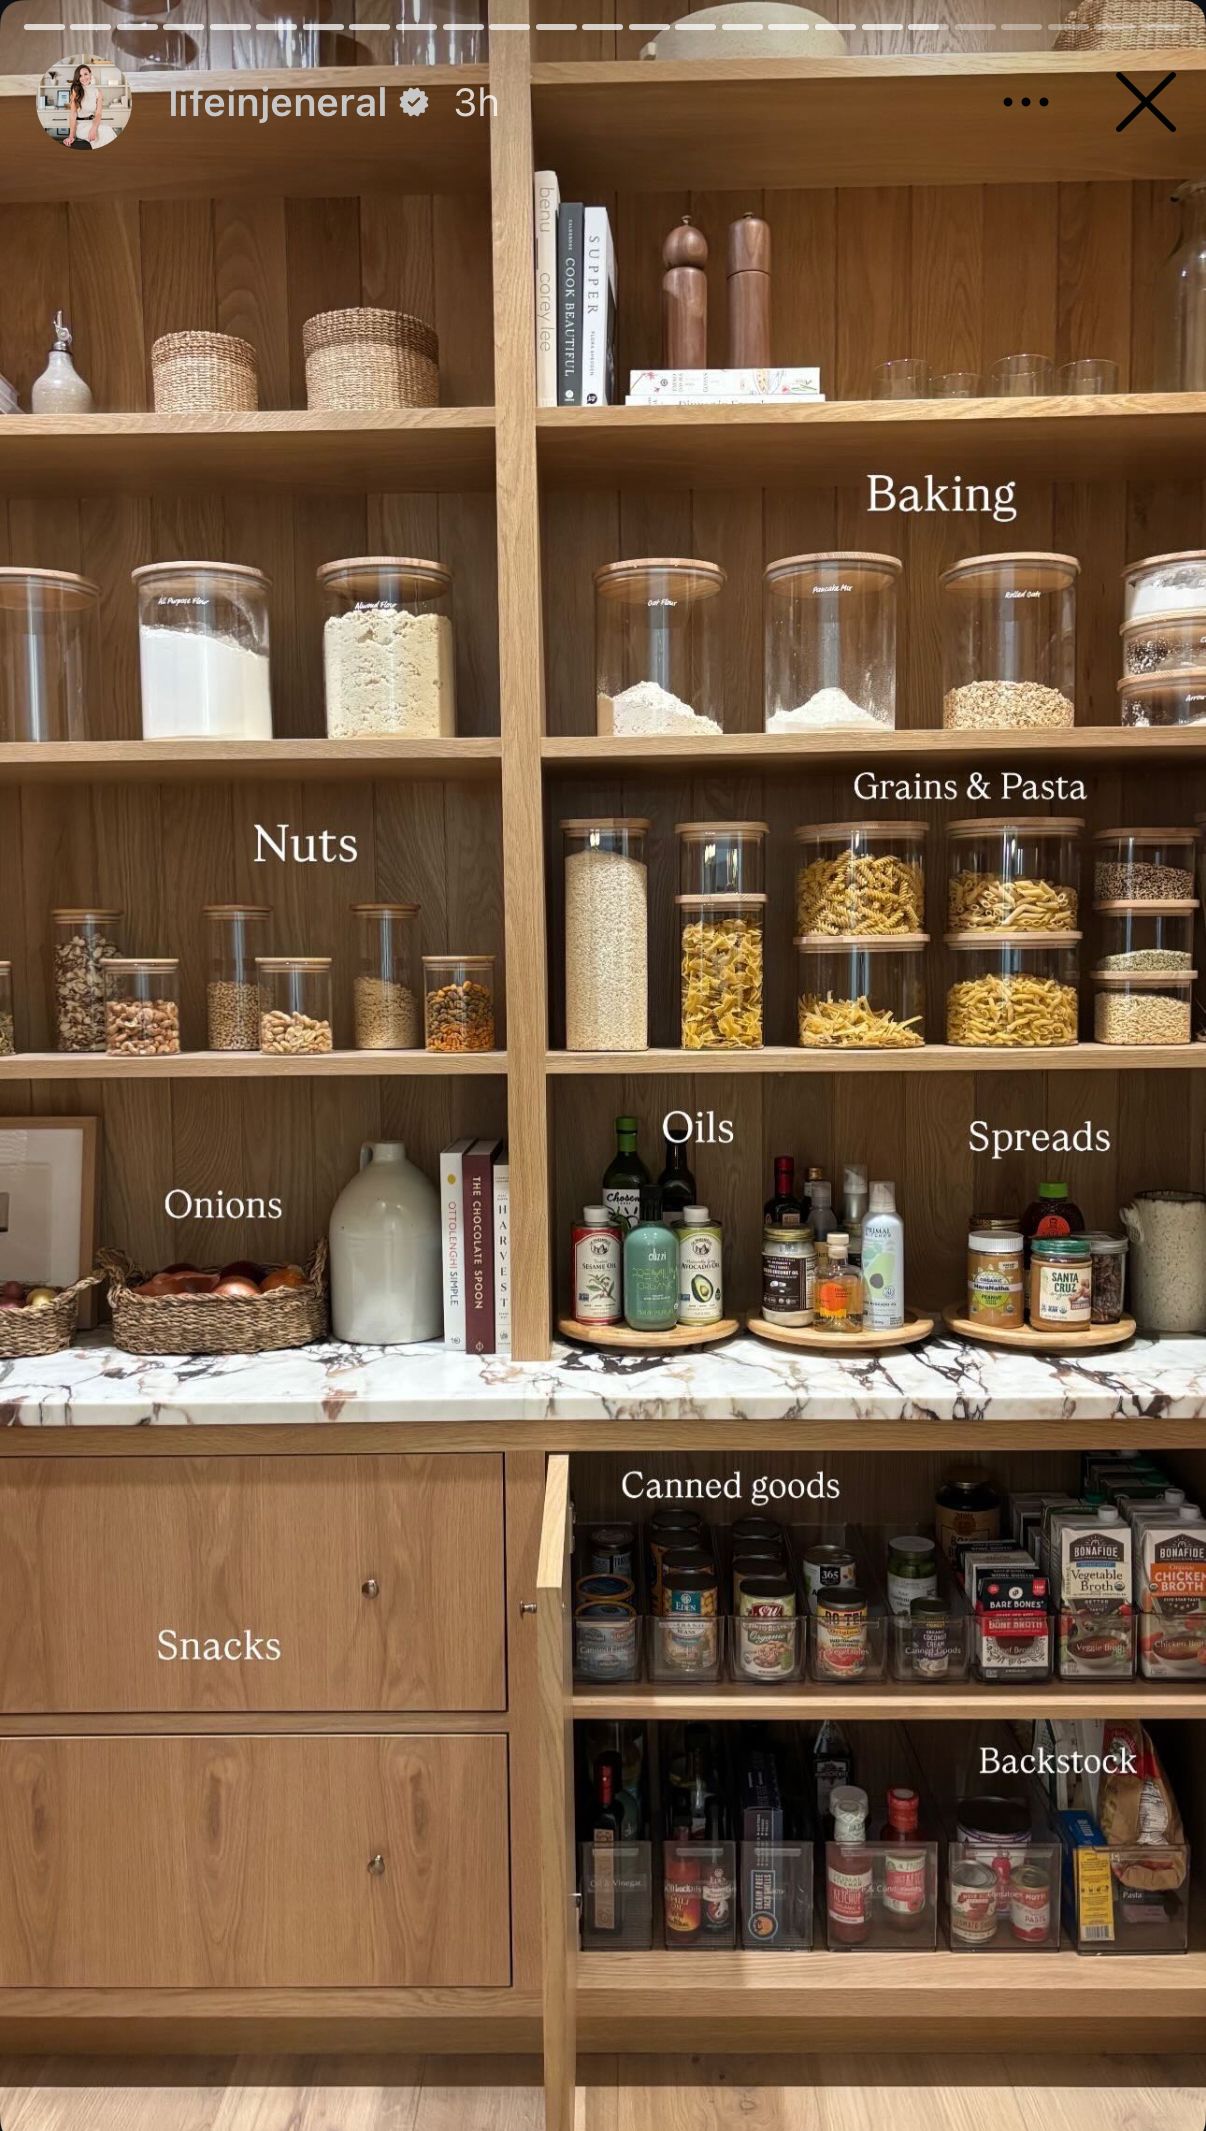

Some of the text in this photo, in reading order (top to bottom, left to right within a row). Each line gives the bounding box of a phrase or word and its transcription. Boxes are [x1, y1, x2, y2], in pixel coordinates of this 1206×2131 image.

[537, 187, 555, 352] benu corey lee
[587, 235, 600, 315] SUPPER
[564, 257, 576, 298] COOK
[563, 302, 576, 377] BEAUTIFUL
[472, 1176, 484, 1309] THE CHOCOLATE SPOON
[448, 1201, 459, 1307] OTTOLENGHI SIMPLE
[498, 1204, 508, 1308] HARVEST
[1052, 1272, 1079, 1283] SANTA
[1054, 1283, 1077, 1293] CRUZ
[1074, 1546, 1118, 1558] BONAFIDE
[1159, 1548, 1205, 1559] BONAFIDE
[822, 1570, 839, 1580] 365
[1071, 1568, 1123, 1581] Vegetable
[1081, 1580, 1114, 1591] Broth
[1161, 1581, 1204, 1592] BROTH
[675, 1601, 697, 1611] EDEN
[990, 1600, 1041, 1609] BARE BONES
[905, 1646, 934, 1654] Canned
[1122, 1891, 1142, 1899] Pasta
